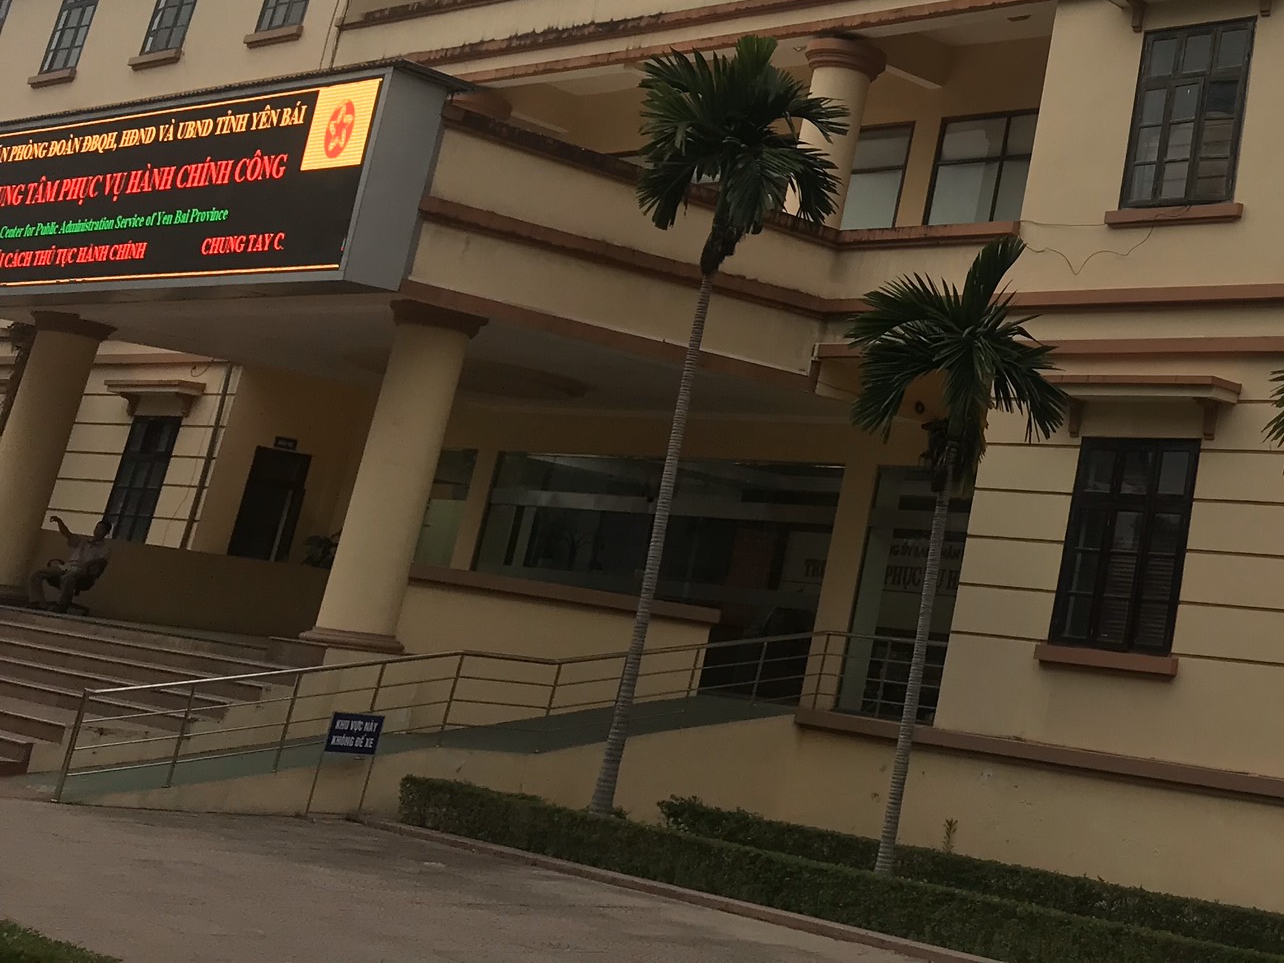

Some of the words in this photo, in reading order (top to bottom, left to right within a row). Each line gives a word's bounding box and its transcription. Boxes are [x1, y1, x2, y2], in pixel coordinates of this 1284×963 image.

[8, 139, 48, 162] PHÒNG
[47, 133, 83, 157] ĐOÀN
[80, 131, 118, 153] ĐBQH,
[119, 126, 156, 147] HĐND
[159, 118, 176, 141] VÀ
[177, 118, 214, 139] UBND
[215, 109, 250, 135] TỈNH
[250, 104, 281, 131] YÊN
[279, 100, 308, 127] BÁI
[25, 175, 60, 205] TÂM
[57, 174, 104, 206] PHỤC
[104, 172, 128, 202] VỤ
[126, 163, 177, 194] HÀNH
[176, 156, 235, 188] CHÍNH
[234, 149, 288, 183] CÔNG
[0, 225, 24, 239] Center
[23, 223, 36, 237] for
[35, 221, 59, 237] Public
[58, 216, 115, 234] Administration
[115, 213, 145, 229] Service
[145, 212, 158, 226] of
[156, 211, 174, 226] Yen
[173, 209, 191, 224] Bai
[189, 206, 229, 223] Province
[4, 248, 34, 268] CÁCH
[33, 244, 57, 267] THỦ
[55, 247, 78, 268] TỤC
[76, 243, 110, 263] HÀNH
[109, 239, 148, 261] CHÍNH
[201, 235, 247, 256] CHUNG
[246, 233, 274, 252] TAY
[884, 565, 923, 590] PHỤC
[331, 734, 355, 747] KHÔNG
[364, 737, 374, 748] XE
[335, 719, 350, 730] KHU
